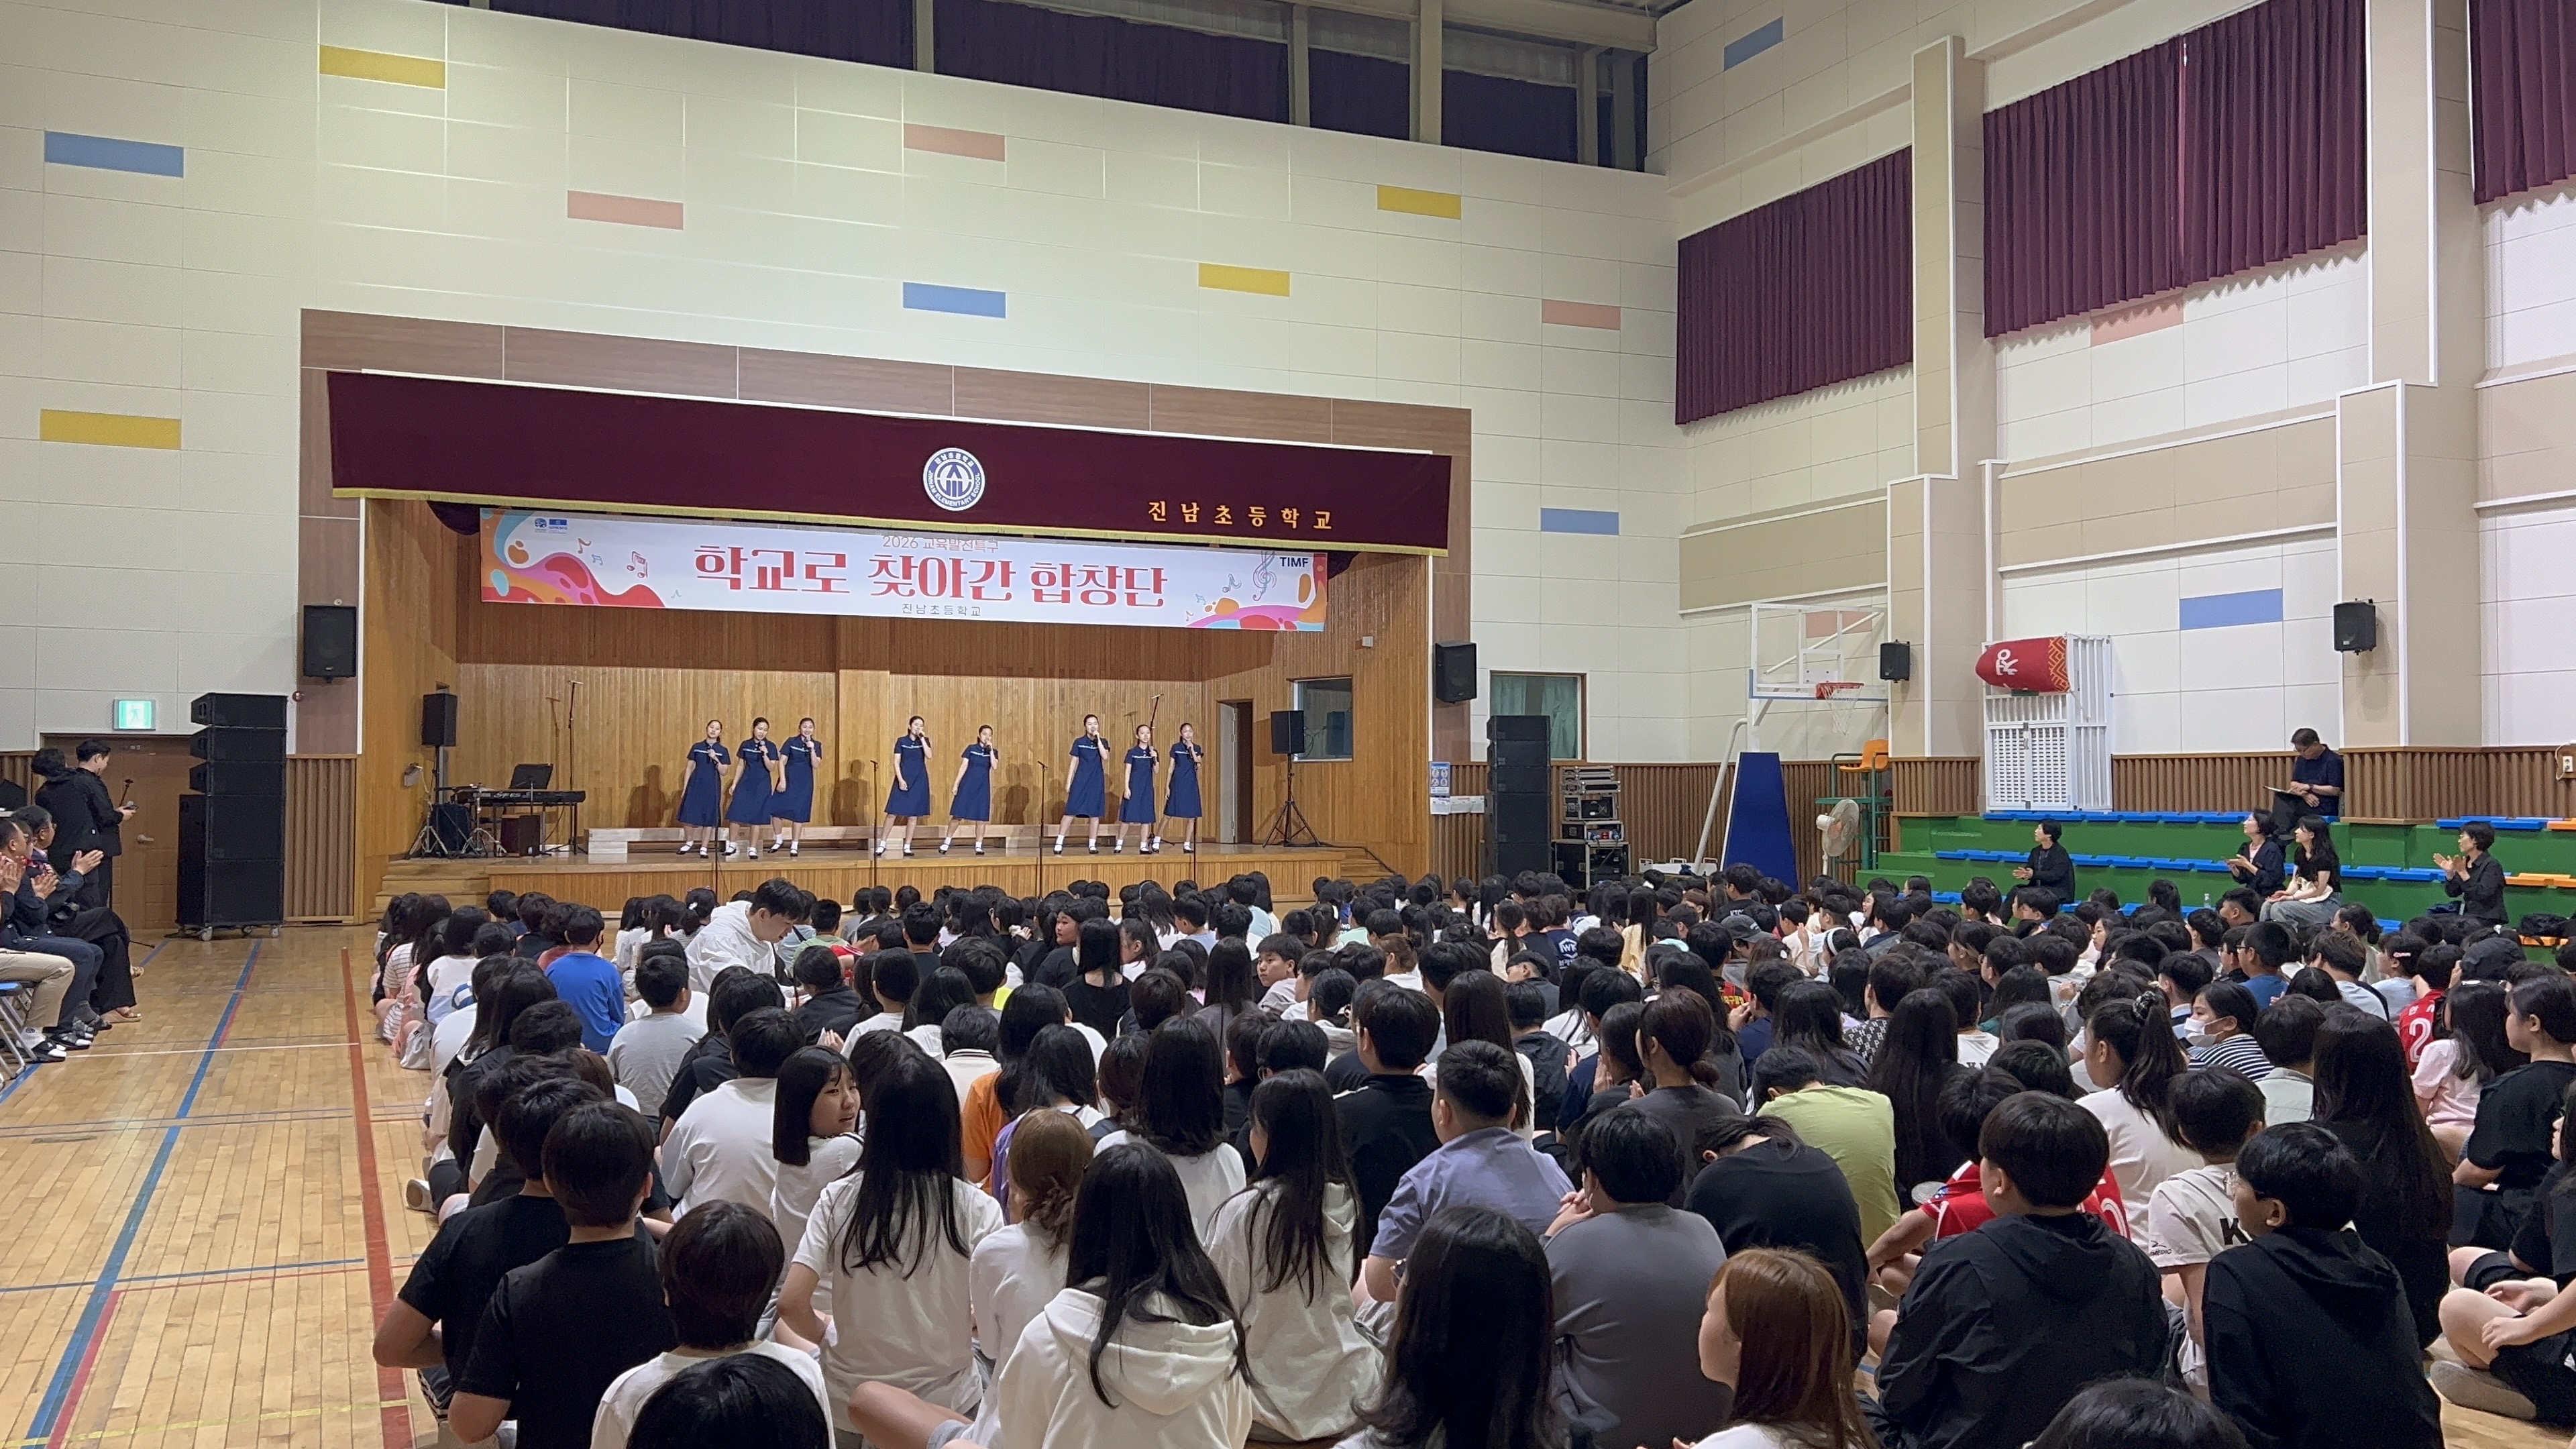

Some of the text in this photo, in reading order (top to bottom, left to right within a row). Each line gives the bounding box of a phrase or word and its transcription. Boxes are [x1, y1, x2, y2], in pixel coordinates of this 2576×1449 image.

[934, 493, 973, 506] ELEMENTARY
[971, 472, 981, 498] SCHOOL
[1147, 500, 1332, 530] 진남초등학교
[882, 536, 1000, 553] 2026 교육발전특구
[1279, 556, 1309, 568] TIMF
[694, 545, 1169, 607] 학교로 찾아간 합창단
[902, 603, 981, 616] 진남초등학교
